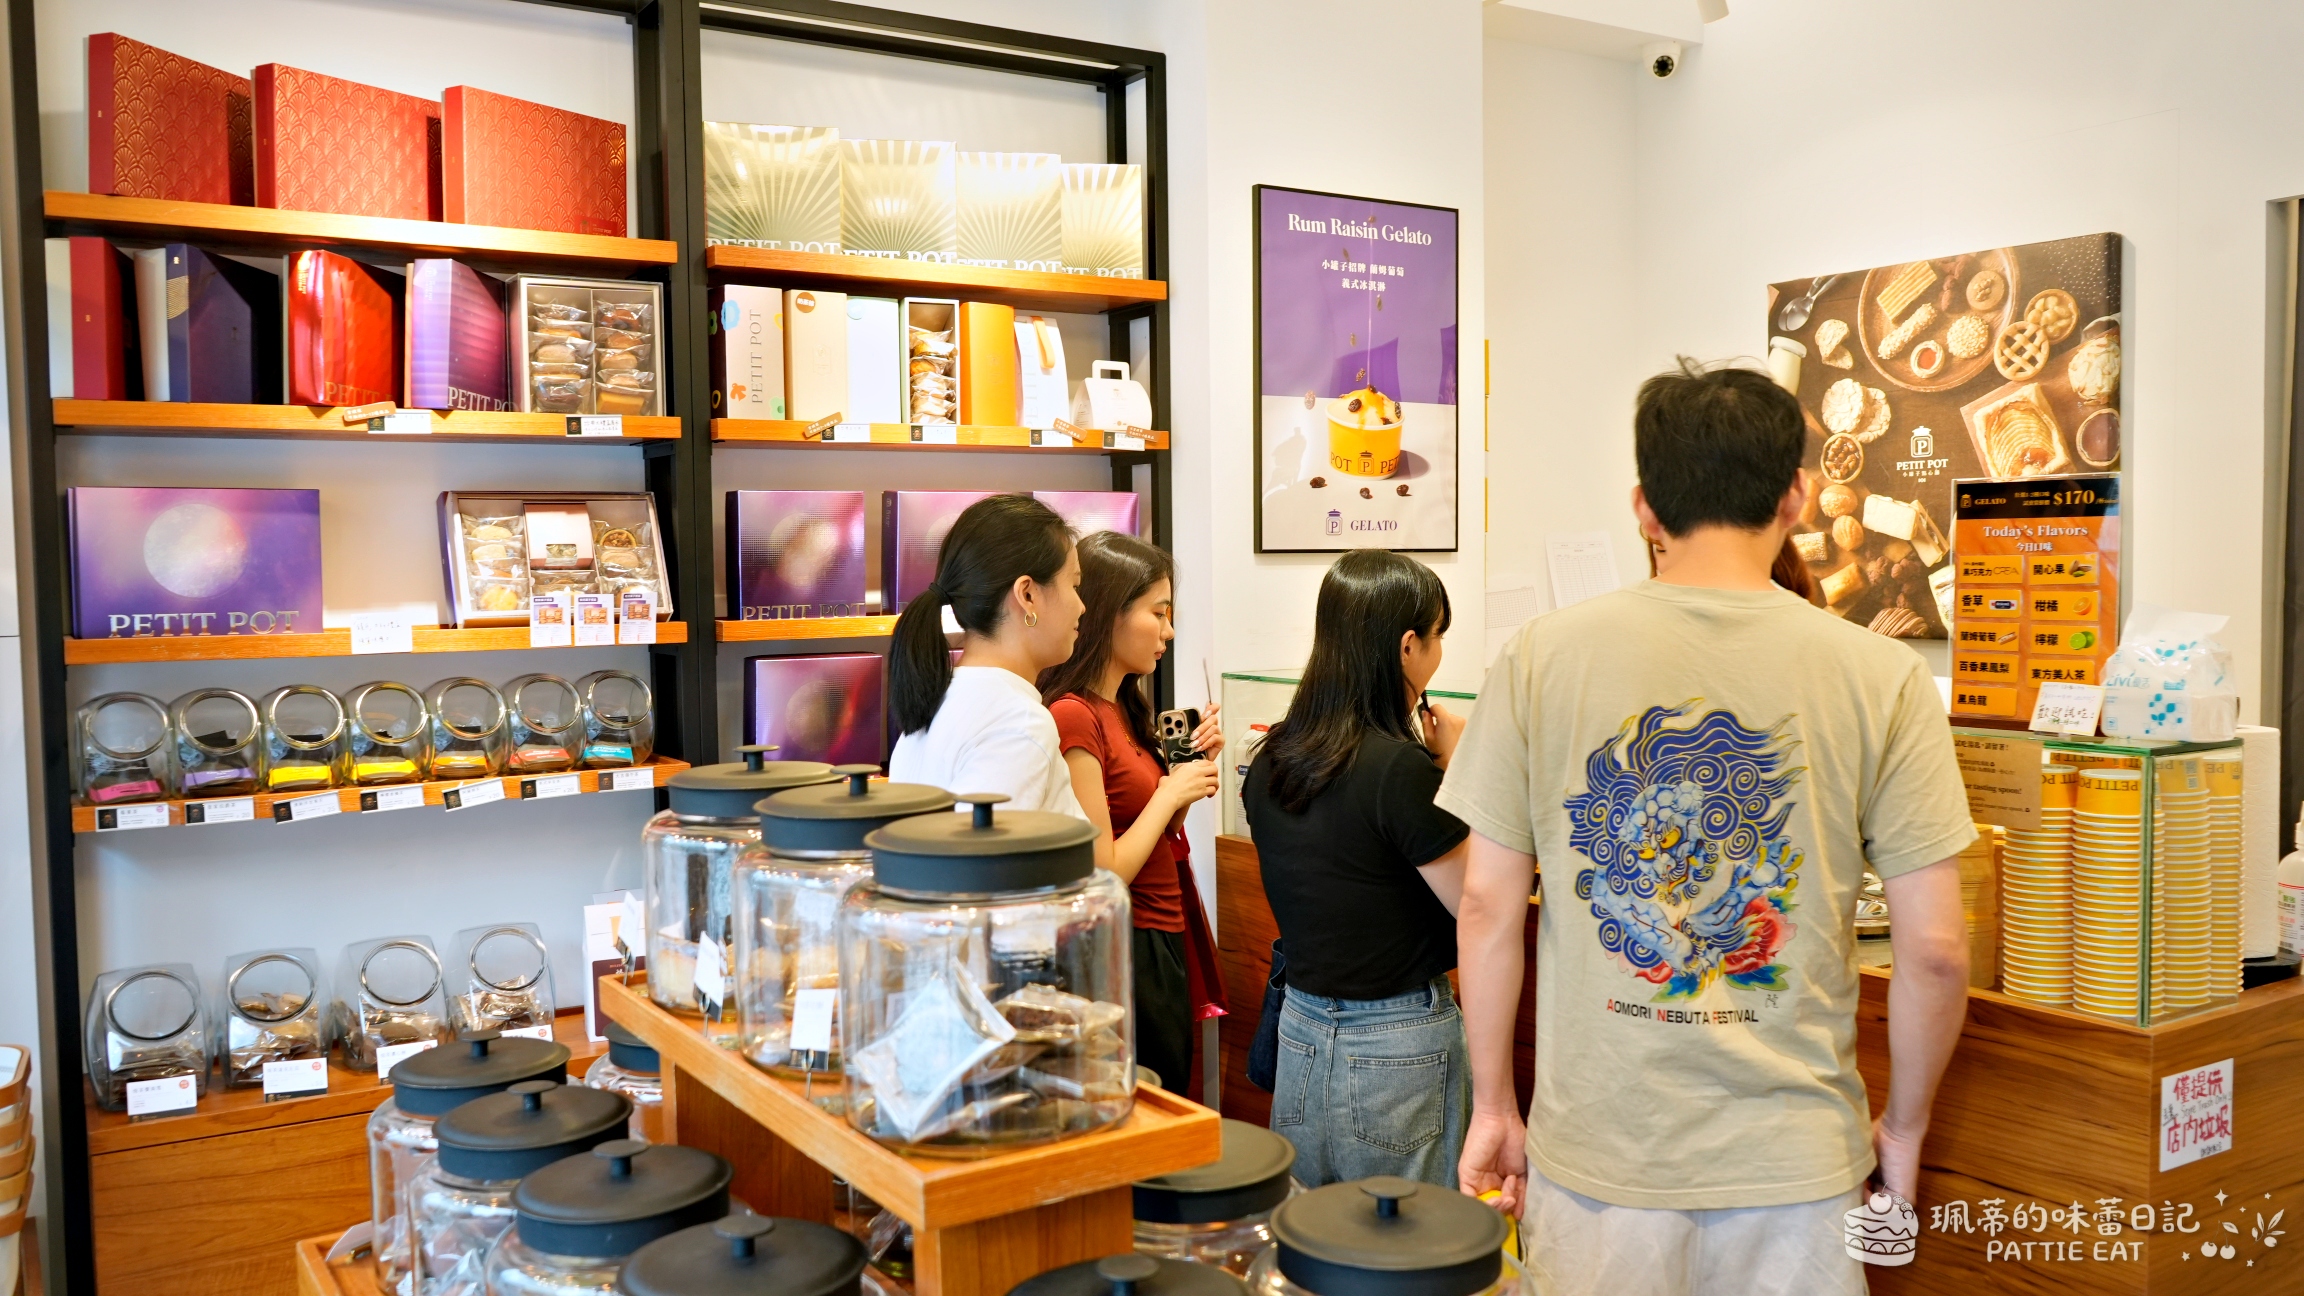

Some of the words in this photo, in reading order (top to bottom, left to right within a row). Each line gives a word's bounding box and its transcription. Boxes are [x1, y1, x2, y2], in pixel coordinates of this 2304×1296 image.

[1287, 213, 1327, 234] Rum
[1330, 218, 1378, 240] Raisin
[1381, 224, 1432, 246] Gelato
[1321, 259, 1366, 274] 小罐子招牌
[1369, 263, 1405, 277] 蘭姆葡萄
[1341, 277, 1387, 292] 義式冰淇淋
[749, 308, 762, 346] POT
[749, 352, 763, 404] PETIT
[447, 386, 491, 411] PETIT
[1330, 451, 1352, 472] POT
[1896, 460, 1926, 471] PETIT
[1927, 458, 1949, 469] POT
[1974, 497, 2007, 506] GELATO
[2053, 489, 2095, 506] $170
[1350, 519, 1398, 531] GELATO
[1983, 525, 2034, 539] Today's
[2037, 525, 2088, 537] Flavors
[2016, 541, 2054, 552] 今日口味
[1962, 568, 1993, 577] 黑巧克力
[2033, 563, 2065, 575] 開心果
[1961, 594, 1984, 607] 香草
[2035, 599, 2059, 612] 柑橘
[742, 604, 811, 620] PETIT
[819, 602, 866, 618] POT
[108, 612, 216, 638] PETIT
[227, 610, 299, 634] POT
[1960, 631, 1997, 642] 蘭姆葡萄
[2035, 633, 2059, 646] 檸檬
[1959, 660, 2010, 674] 百香果鳳梨
[2031, 668, 2086, 681] 東方美人茶
[1957, 694, 1988, 706] 黑烏龍
[1606, 998, 1651, 1019] AOMORI
[1657, 1008, 1709, 1025] NEBUTA
[1713, 1010, 1759, 1024] FESTIVAL
[2167, 1104, 2232, 1154] 店內垃圾
